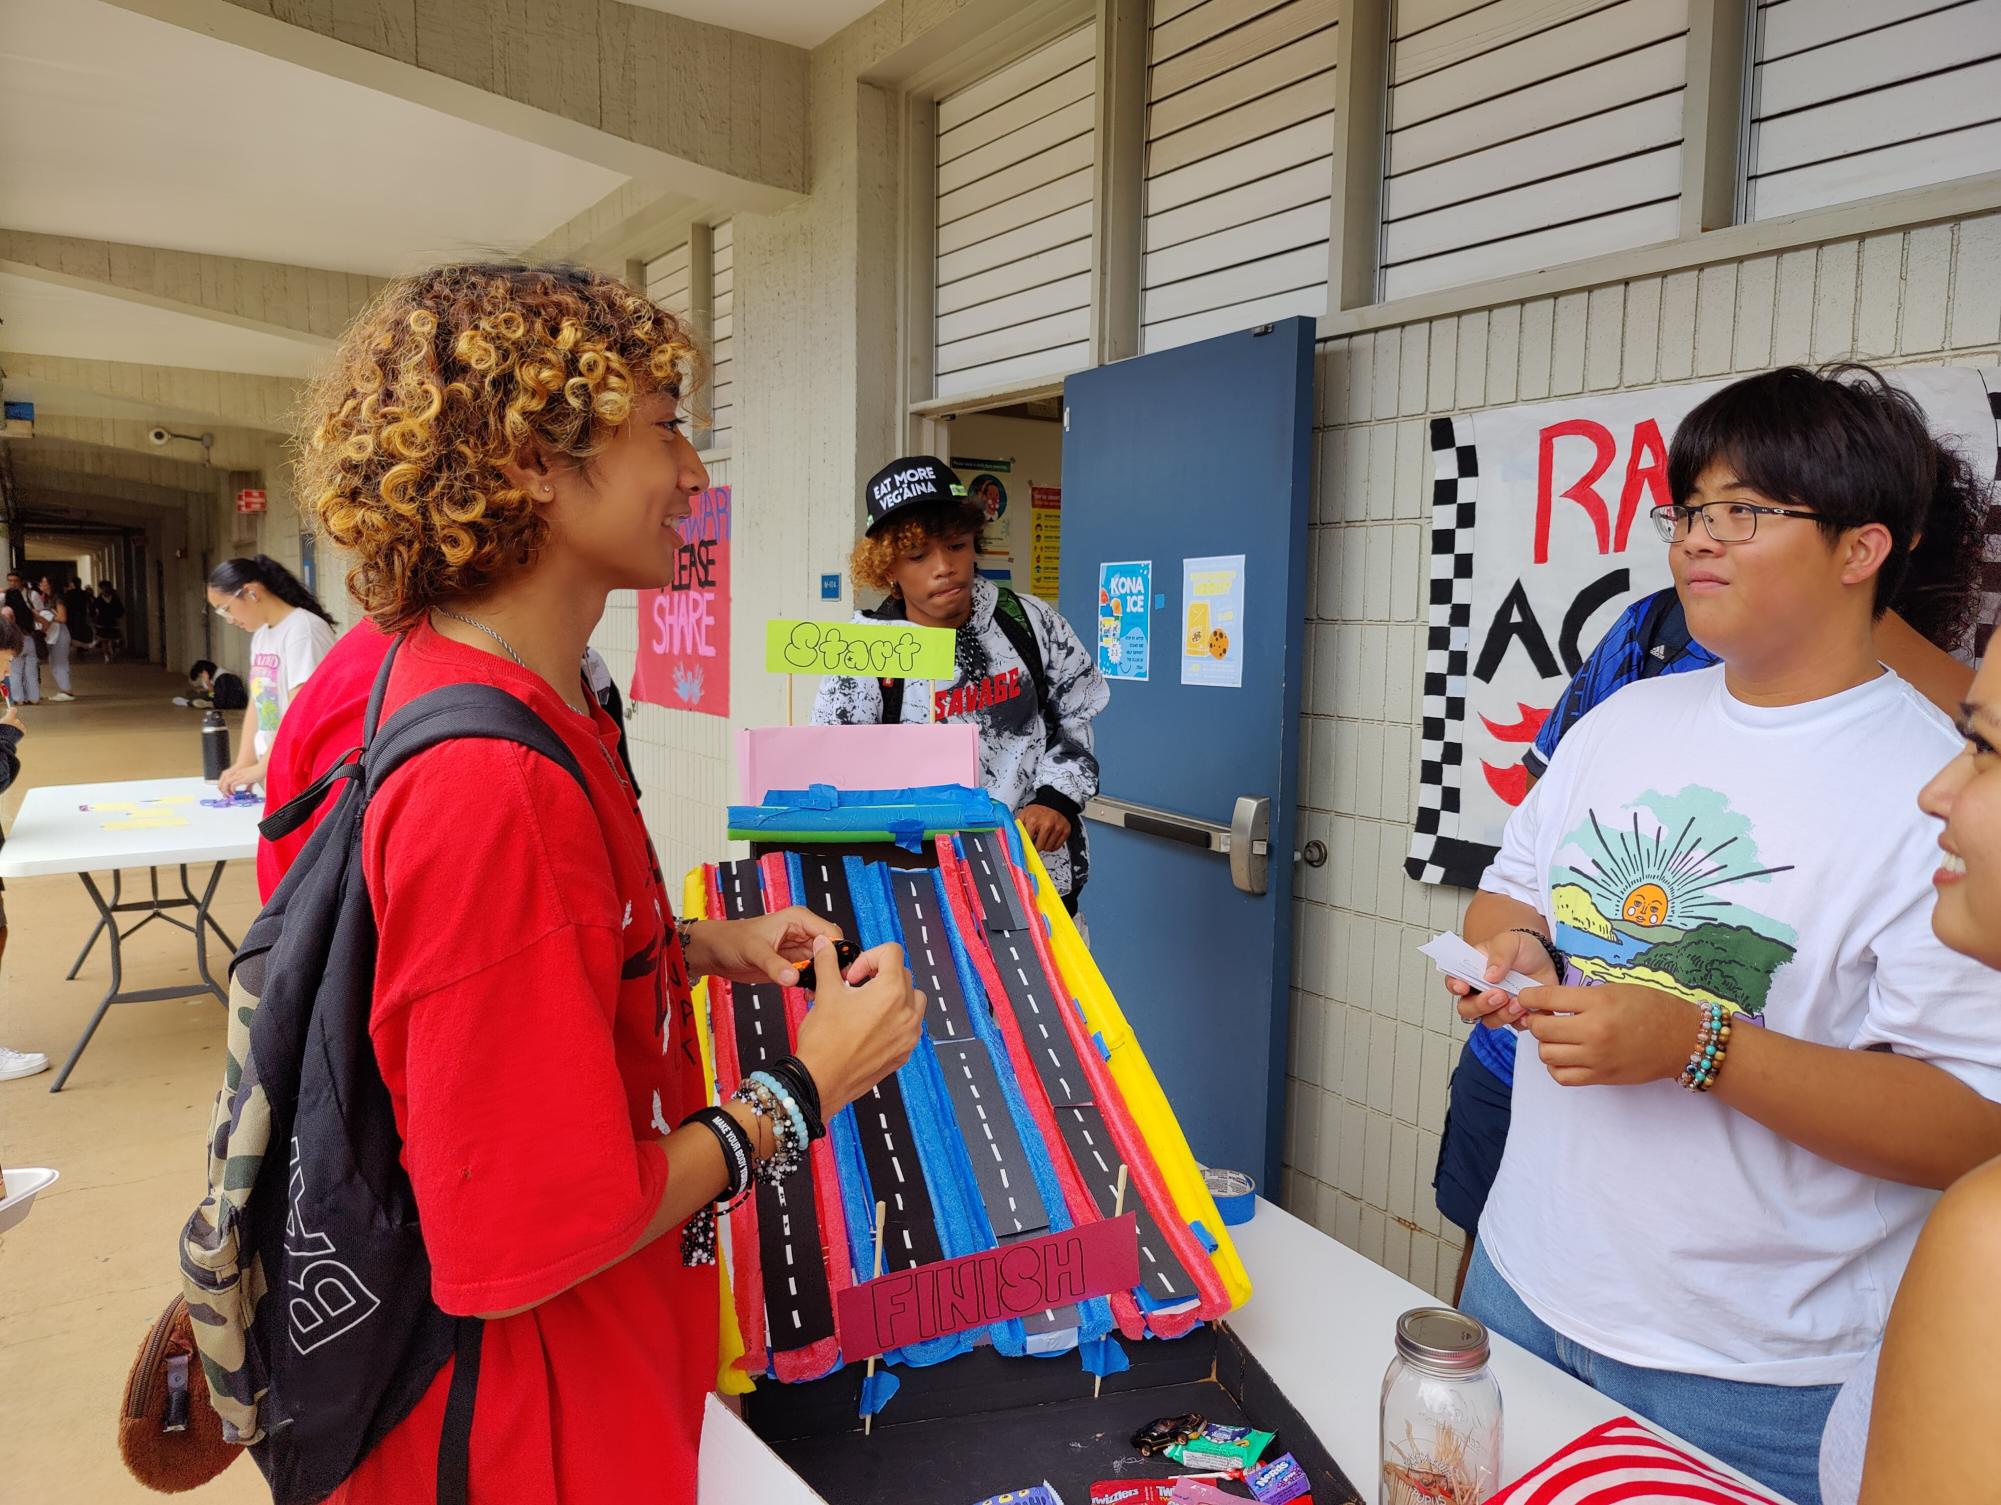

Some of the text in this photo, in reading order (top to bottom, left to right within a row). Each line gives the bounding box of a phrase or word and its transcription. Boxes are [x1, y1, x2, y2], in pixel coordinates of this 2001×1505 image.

[873, 477, 892, 500] EAT
[893, 466, 936, 487] MORE
[1534, 417, 1673, 565] RA
[1109, 575, 1144, 595] KONA
[1126, 594, 1144, 613] ICE
[652, 591, 717, 657] SHARE
[784, 621, 922, 672] Start
[1472, 567, 1630, 685] AC
[934, 667, 1021, 721] SAVAGE
[712, 1115, 731, 1135] MAKE
[725, 1130, 742, 1153] YOUR
[871, 1237, 1086, 1349] FINISH
